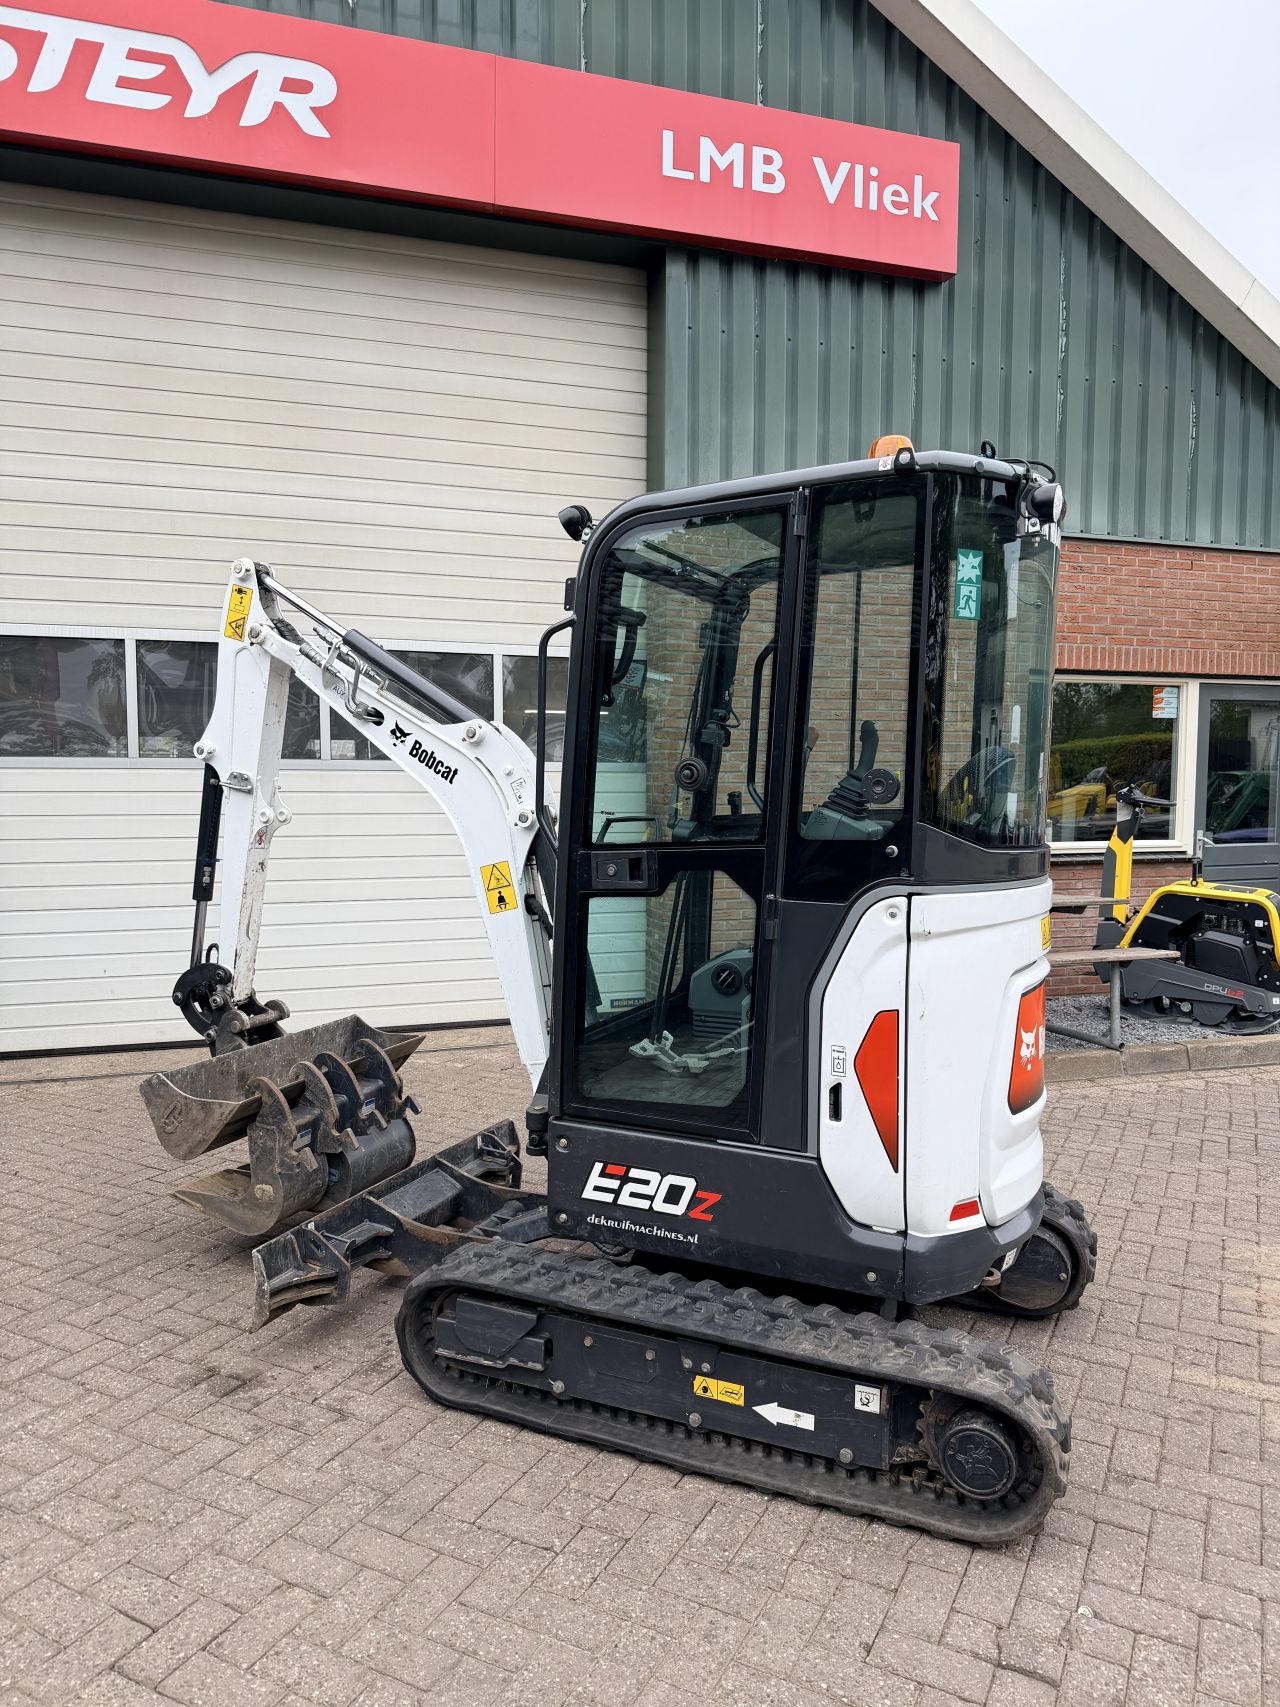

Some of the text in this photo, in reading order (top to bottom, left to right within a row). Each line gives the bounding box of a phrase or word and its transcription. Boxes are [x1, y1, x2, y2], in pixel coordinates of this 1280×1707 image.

[662, 129, 940, 222] LMB Vliek
[408, 739, 459, 785] Bobcat
